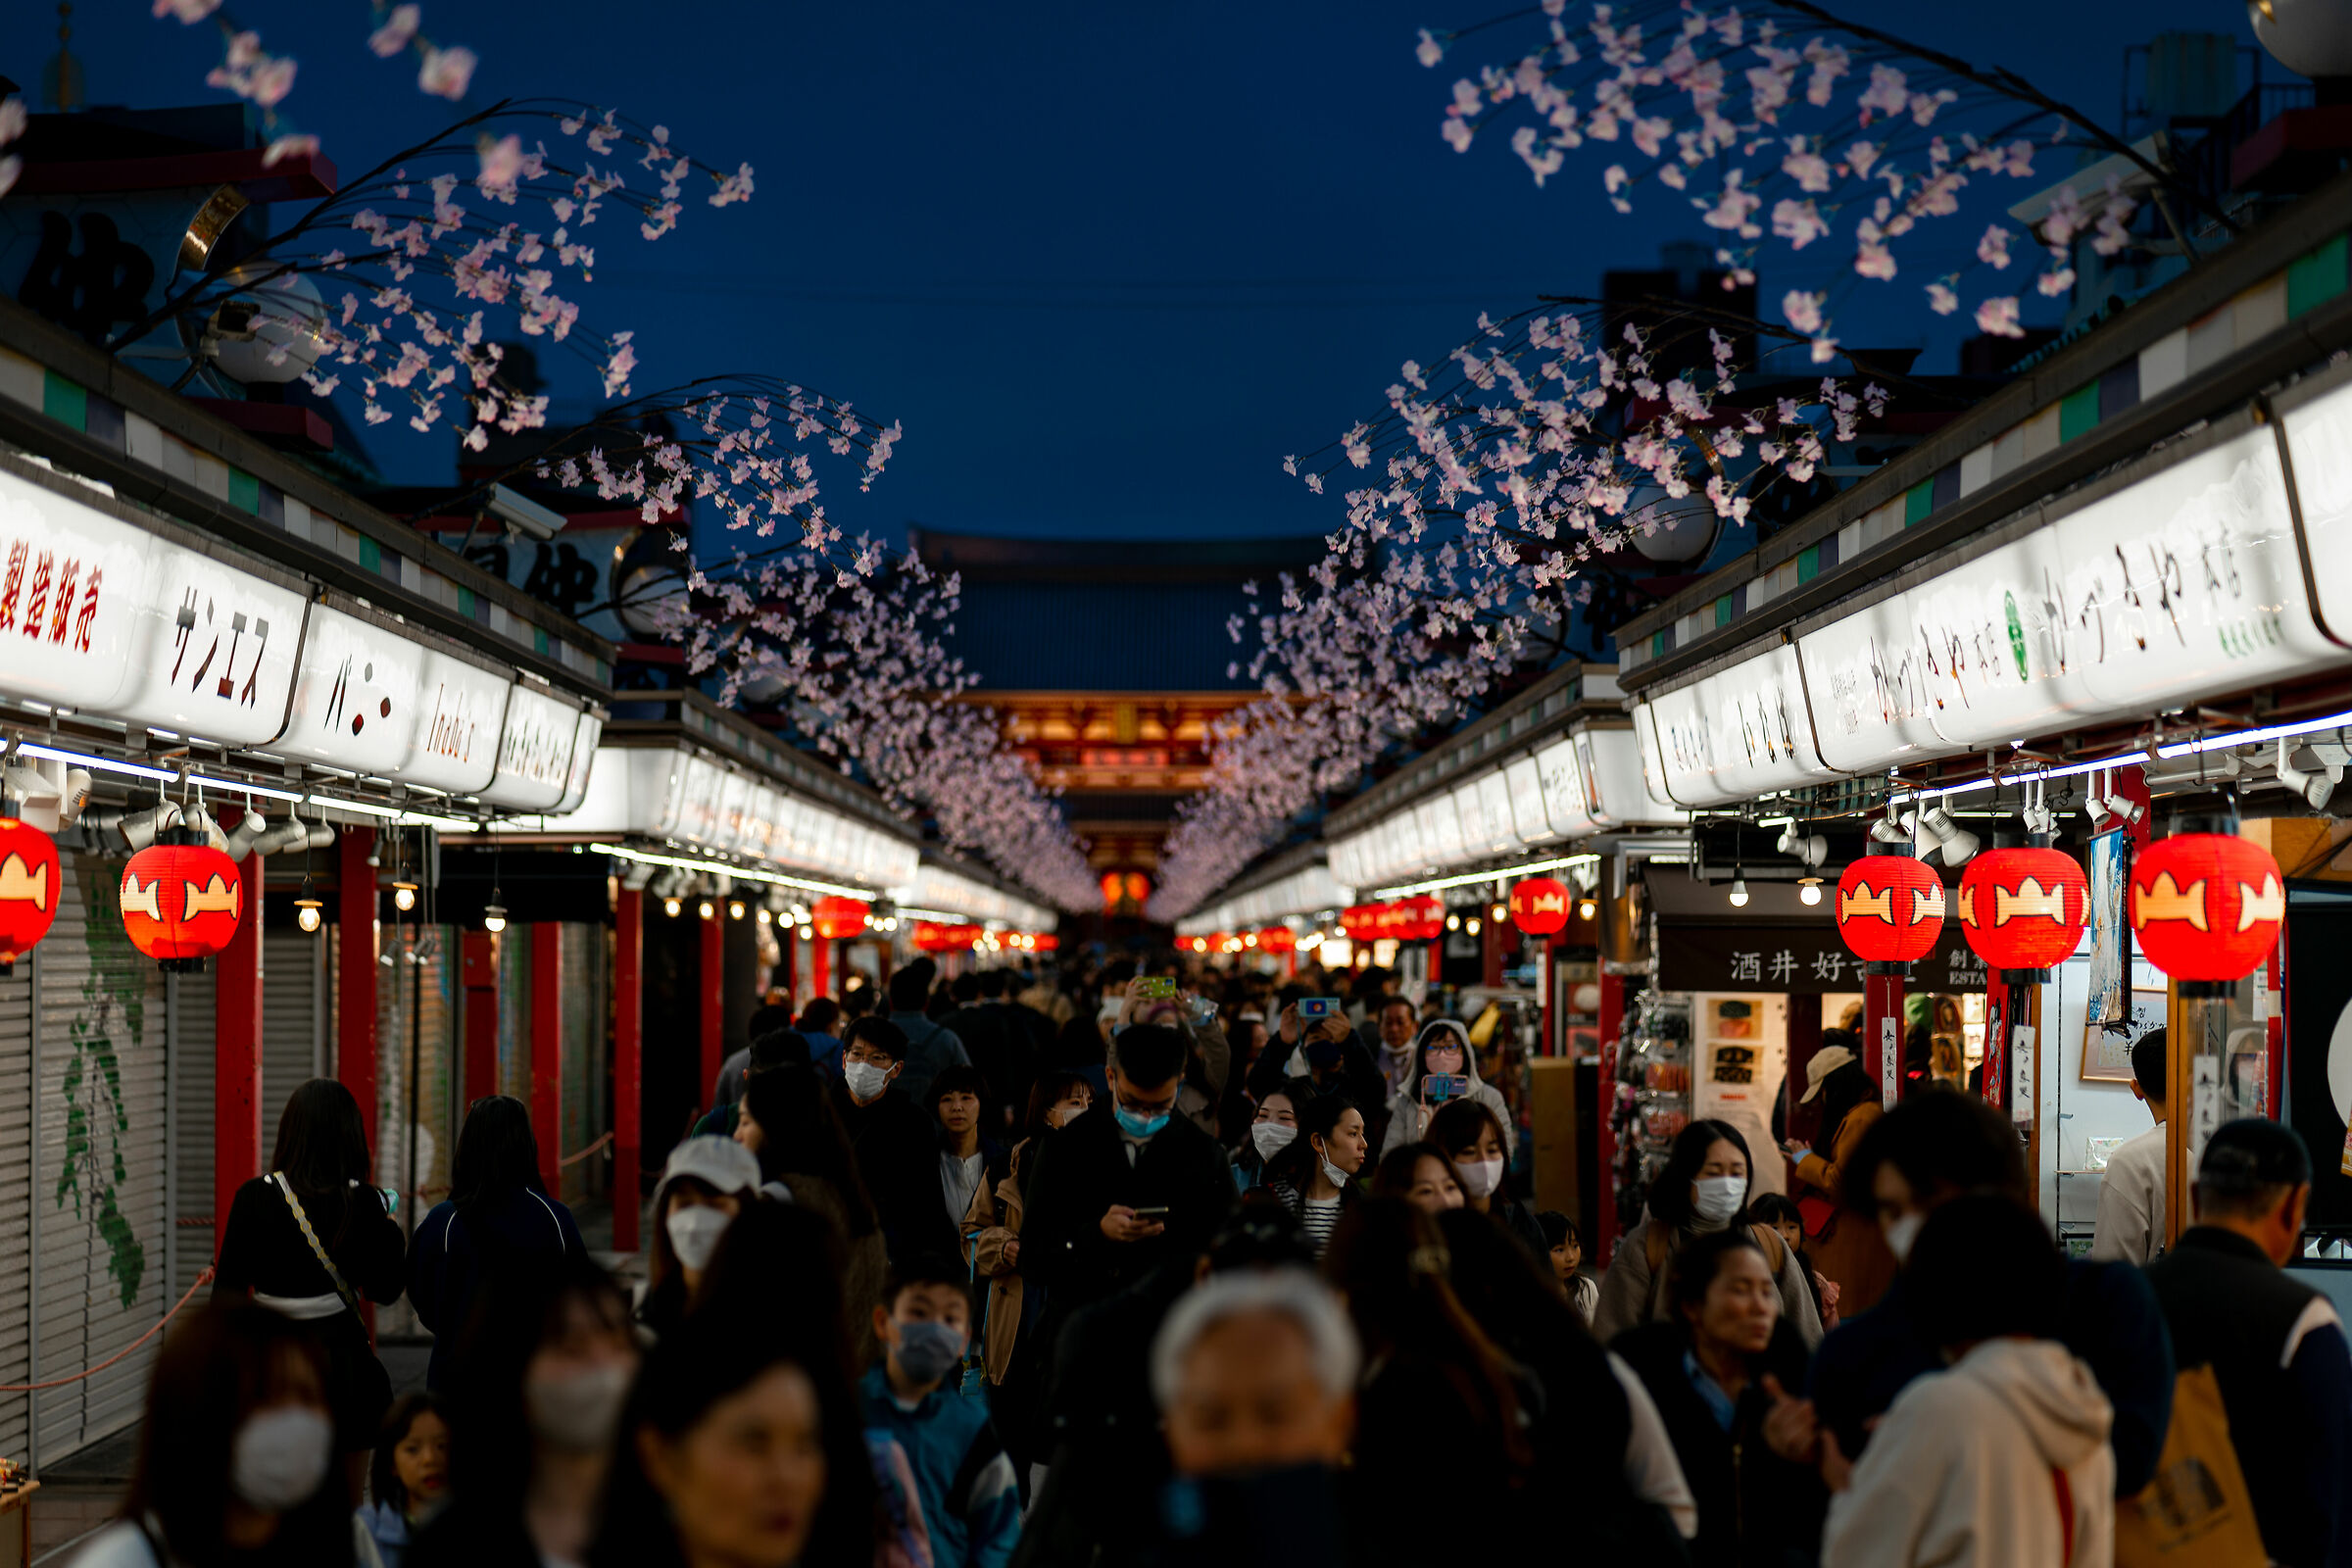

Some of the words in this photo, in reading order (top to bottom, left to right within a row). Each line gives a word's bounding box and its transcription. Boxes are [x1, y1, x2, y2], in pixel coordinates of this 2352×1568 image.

[171, 585, 270, 710] サンエス
[1949, 971, 1987, 985] ESTA
